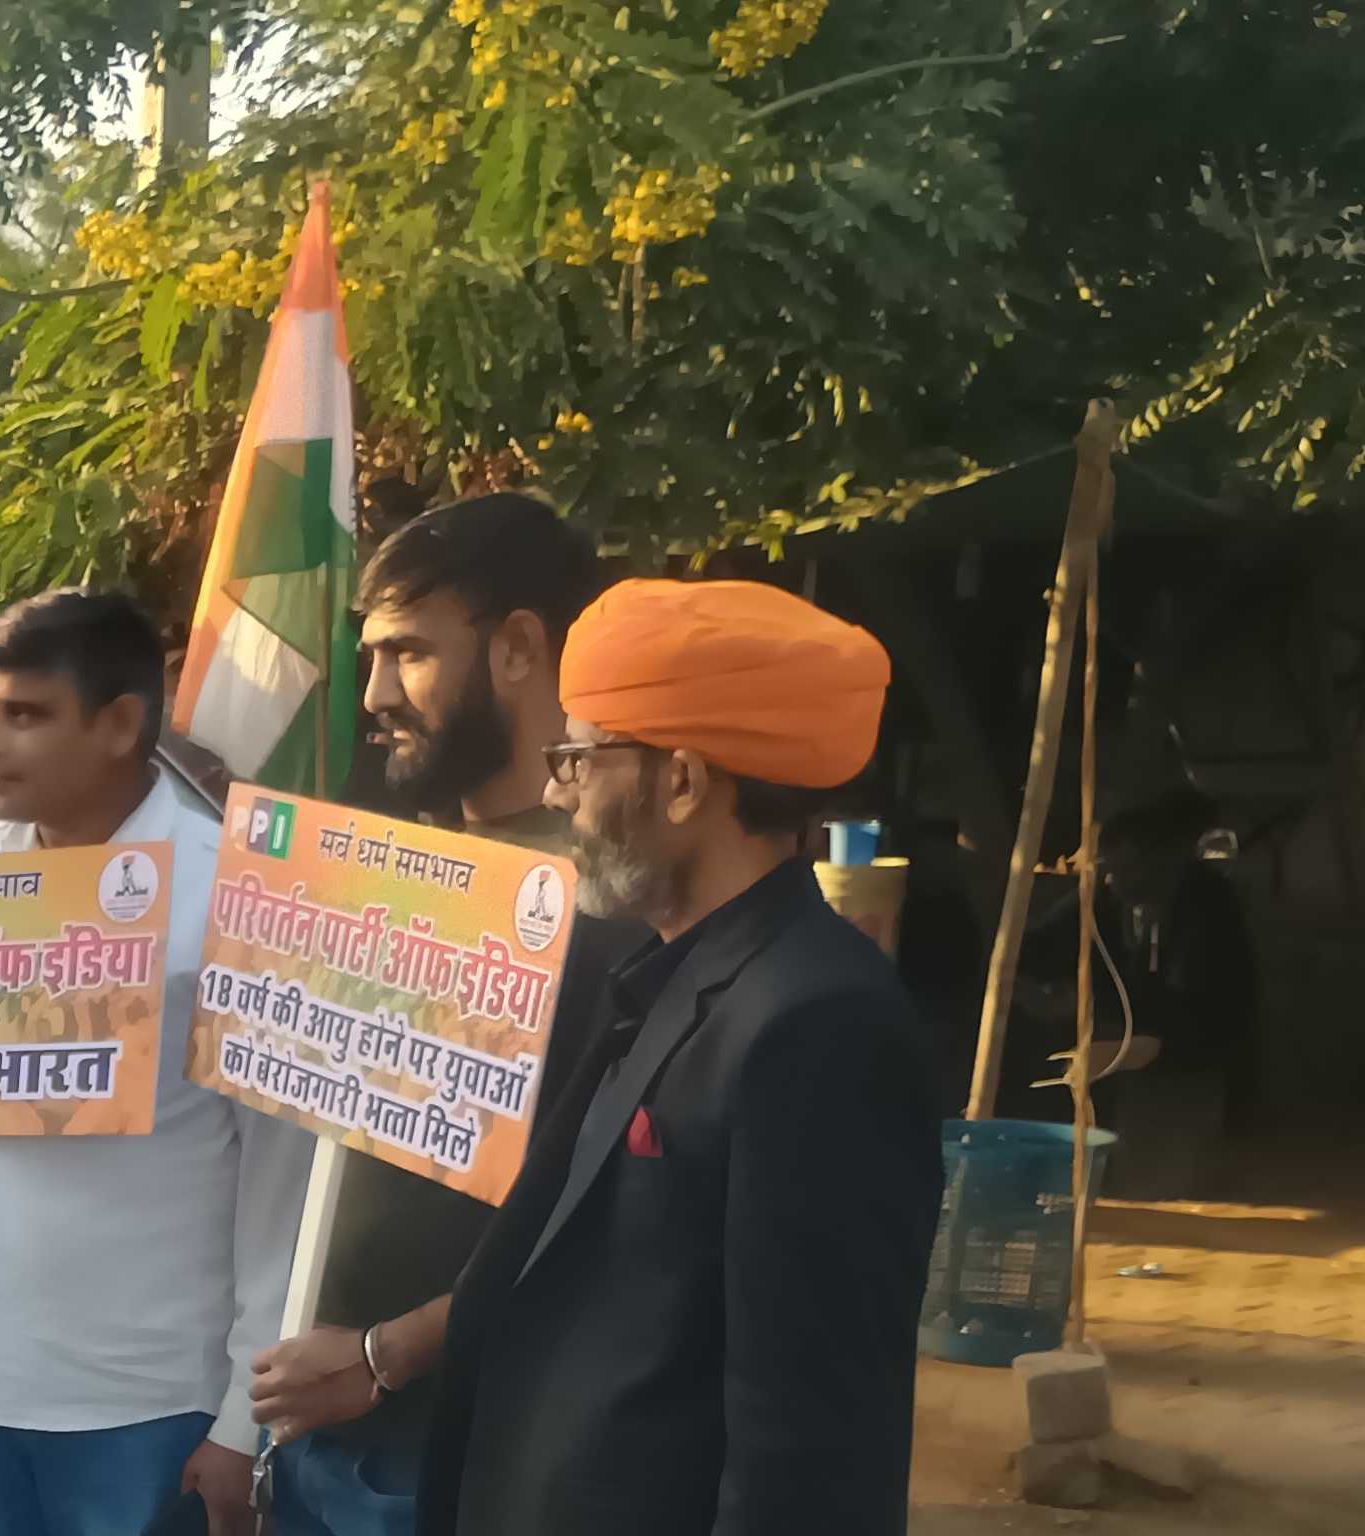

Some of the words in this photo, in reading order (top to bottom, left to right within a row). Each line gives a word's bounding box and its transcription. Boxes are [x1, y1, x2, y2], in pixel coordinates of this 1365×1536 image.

[41, 925, 154, 995] इंडिया
[216, 875, 319, 958] परिवर्तन
[322, 907, 387, 977] पार्टी
[385, 918, 457, 995] ऑफ
[460, 935, 549, 1028] इंडिया
[205, 970, 231, 1006] 18
[238, 977, 271, 1022] वर्ष
[271, 986, 302, 1031] की
[307, 1001, 353, 1062] आयु
[358, 1014, 405, 1066] होने
[410, 1040, 440, 1080] पर
[448, 1049, 533, 1112] युवाओं
[224, 1037, 254, 1079] को
[257, 1046, 362, 1121] बेरोजगारी
[368, 1092, 420, 1143] भत्ता
[423, 1105, 475, 1164] मिले
